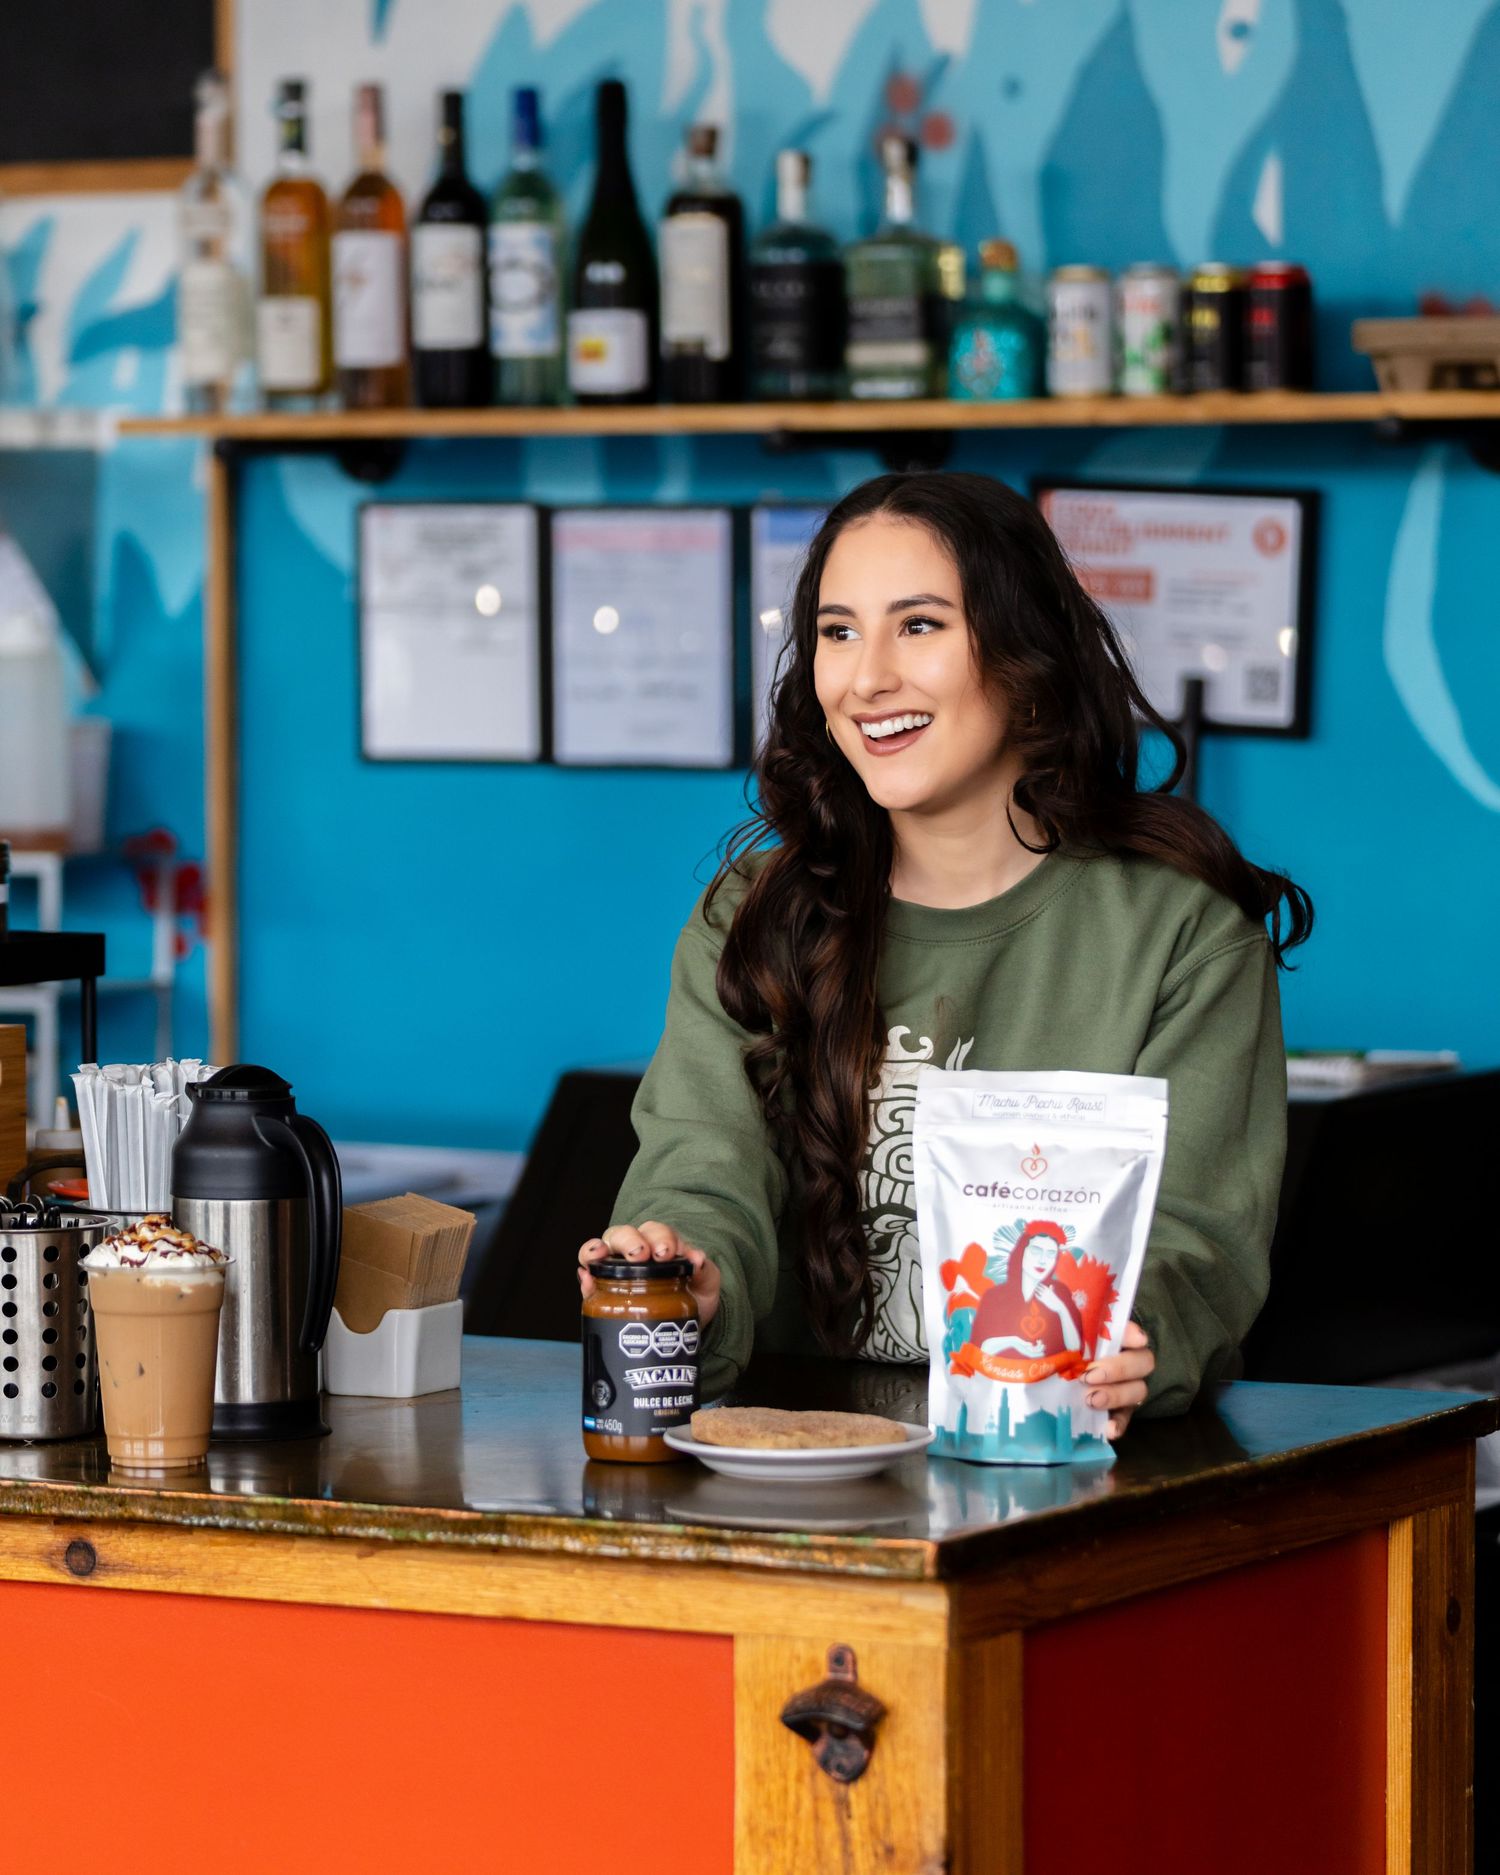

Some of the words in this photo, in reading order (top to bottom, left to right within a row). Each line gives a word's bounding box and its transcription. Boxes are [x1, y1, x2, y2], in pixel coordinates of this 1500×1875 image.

[977, 1093, 1020, 1110] Machu
[1023, 1094, 1063, 1110] Picchu
[1066, 1097, 1104, 1113] Roast
[962, 1181, 1101, 1204] cafécorazón
[1039, 1205, 1068, 1213] coffee
[981, 1353, 1024, 1378] Kansas
[1029, 1362, 1056, 1377] City
[632, 1368, 693, 1384] VACALIN
[634, 1397, 660, 1408] DULCE
[662, 1397, 673, 1407] DE
[674, 1395, 693, 1406] LECHE
[604, 1419, 622, 1434] 450g
